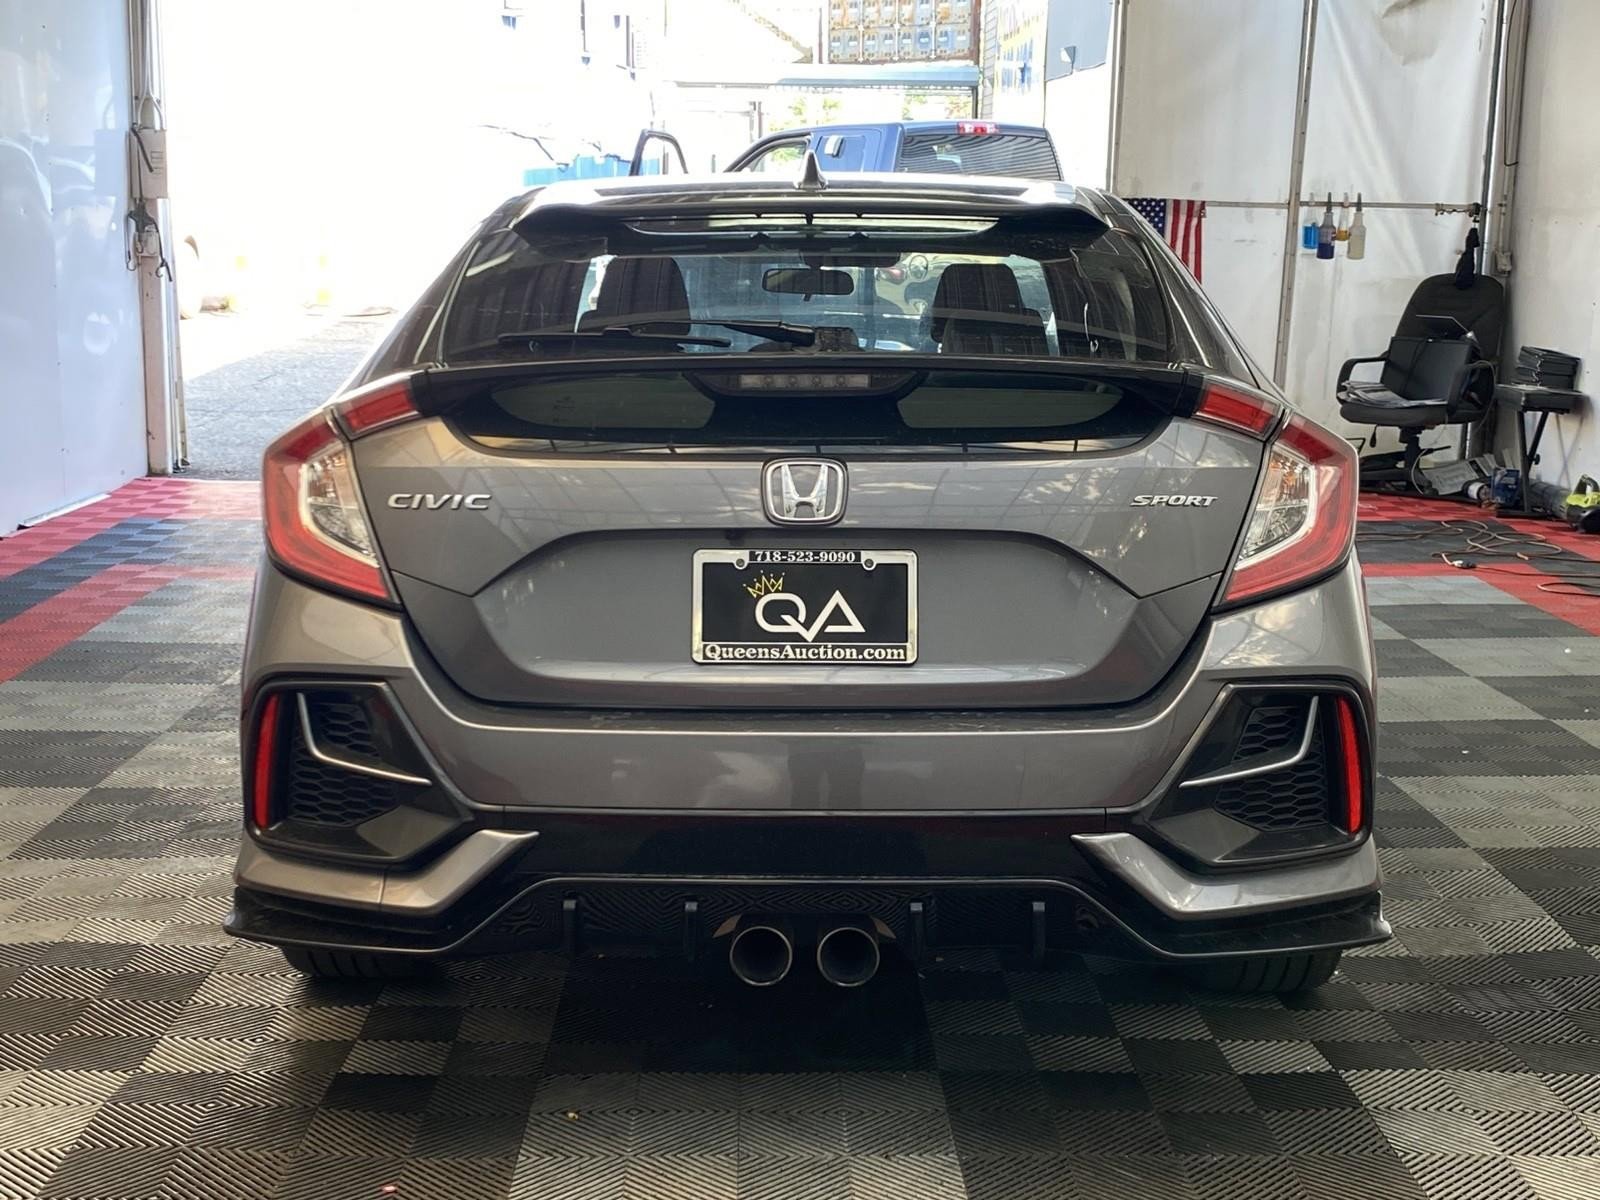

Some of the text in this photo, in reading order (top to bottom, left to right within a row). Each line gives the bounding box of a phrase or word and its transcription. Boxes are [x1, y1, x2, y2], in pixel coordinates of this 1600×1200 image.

[387, 493, 491, 509] CIVIC
[1130, 495, 1218, 507] SPORT
[755, 551, 855, 562] 718-523-9090
[755, 590, 866, 643] QA
[705, 644, 905, 661] QueensAuction.com
